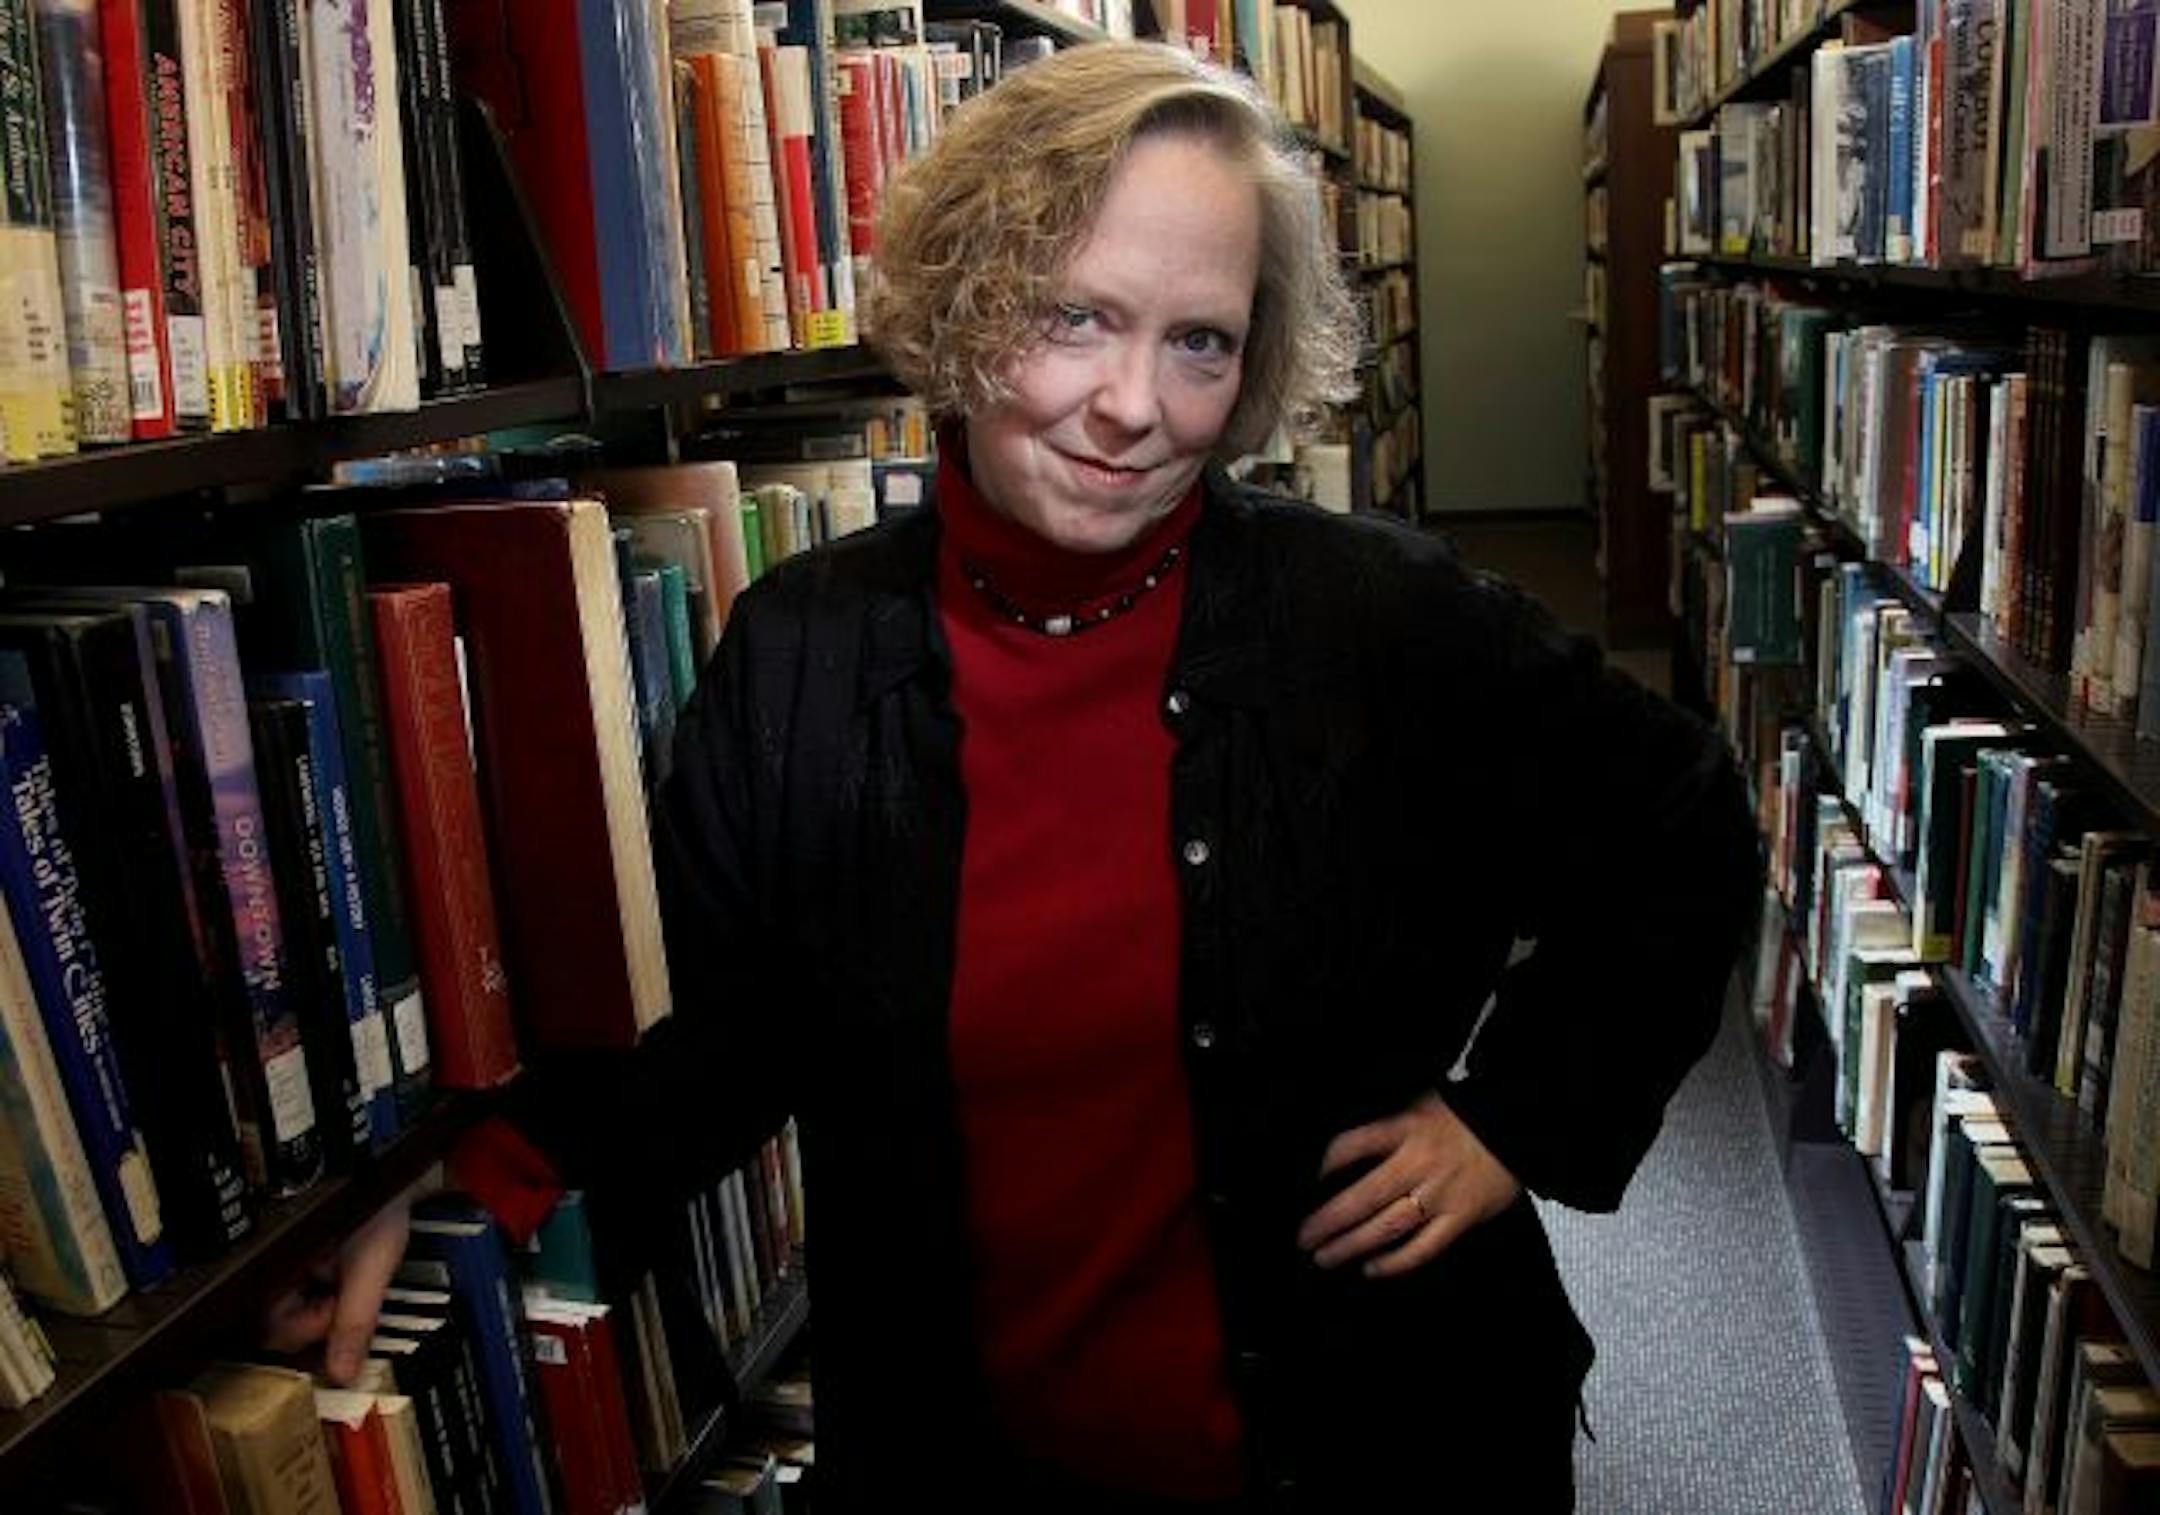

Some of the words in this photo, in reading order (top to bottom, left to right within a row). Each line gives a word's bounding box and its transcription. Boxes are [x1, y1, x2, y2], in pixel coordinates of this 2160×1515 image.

[153, 51, 190, 218] AMERICAN
[169, 224, 200, 297] CITY
[11, 780, 46, 857] Tales
[32, 857, 60, 890] of
[234, 814, 283, 992] DOWNTOWN
[39, 884, 76, 963] Twin
[62, 961, 99, 1055] Cities
